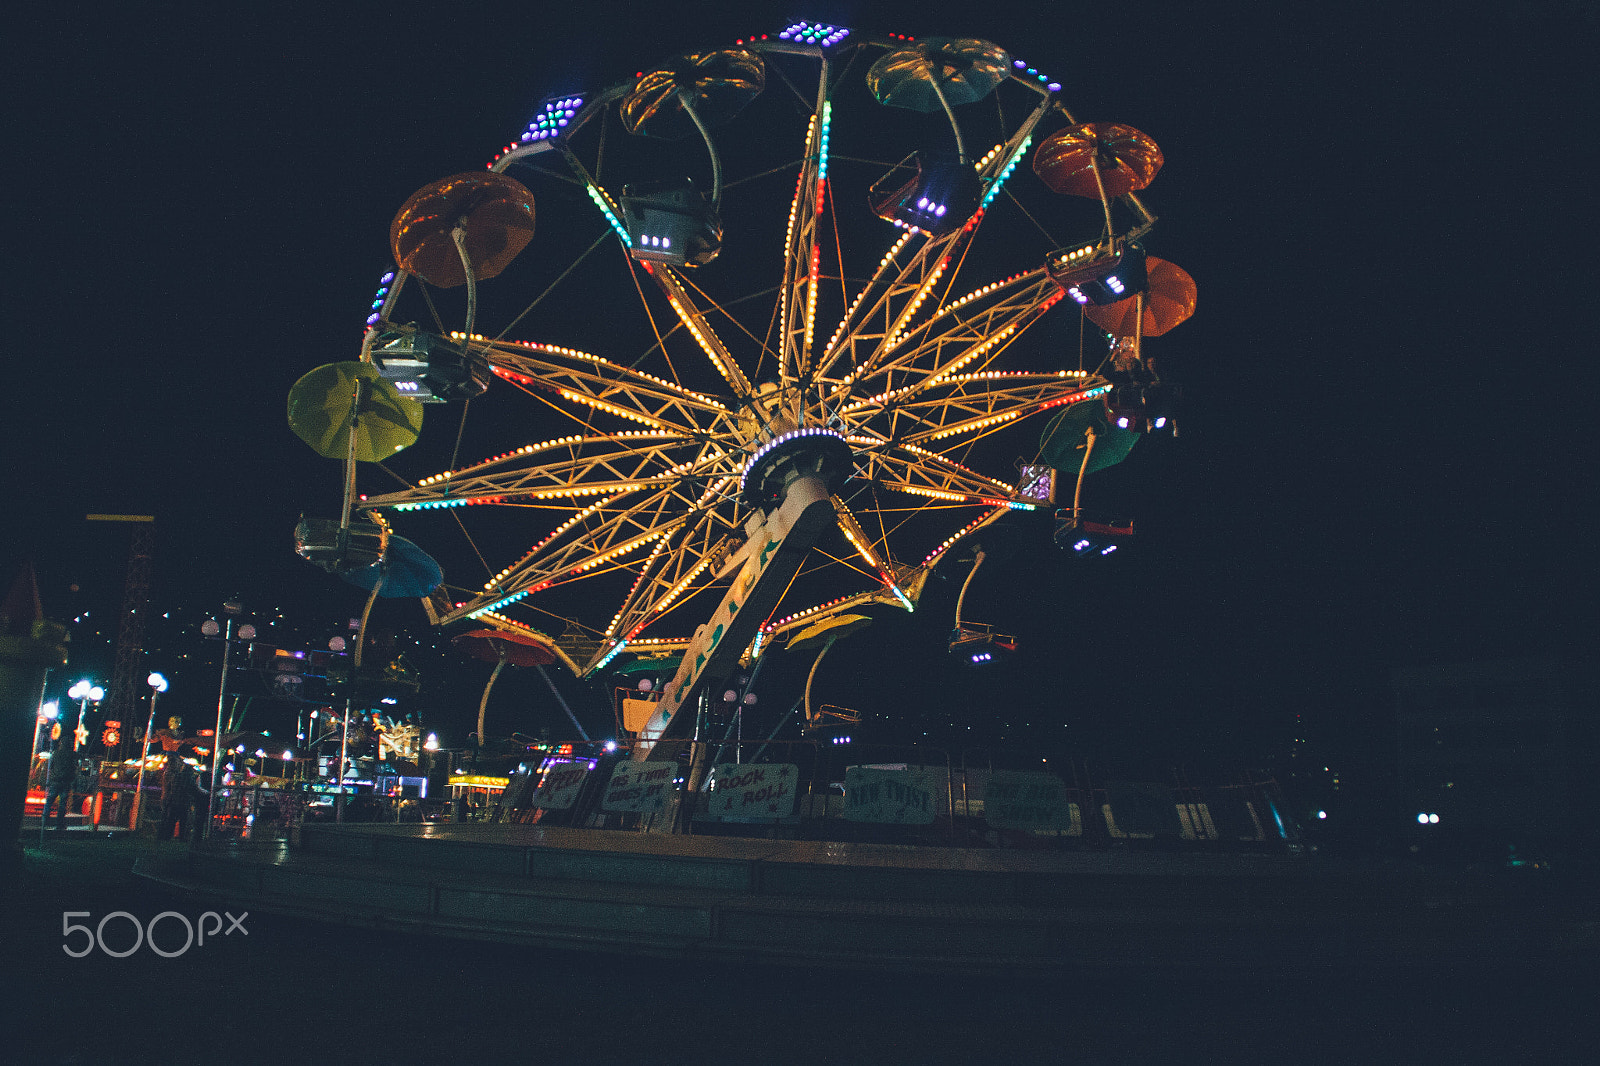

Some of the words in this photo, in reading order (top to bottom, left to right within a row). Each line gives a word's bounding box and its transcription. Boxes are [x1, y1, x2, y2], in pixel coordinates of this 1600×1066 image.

[634, 767, 671, 783] TIME
[716, 769, 765, 794] ROCK
[742, 782, 788, 806] ROLL
